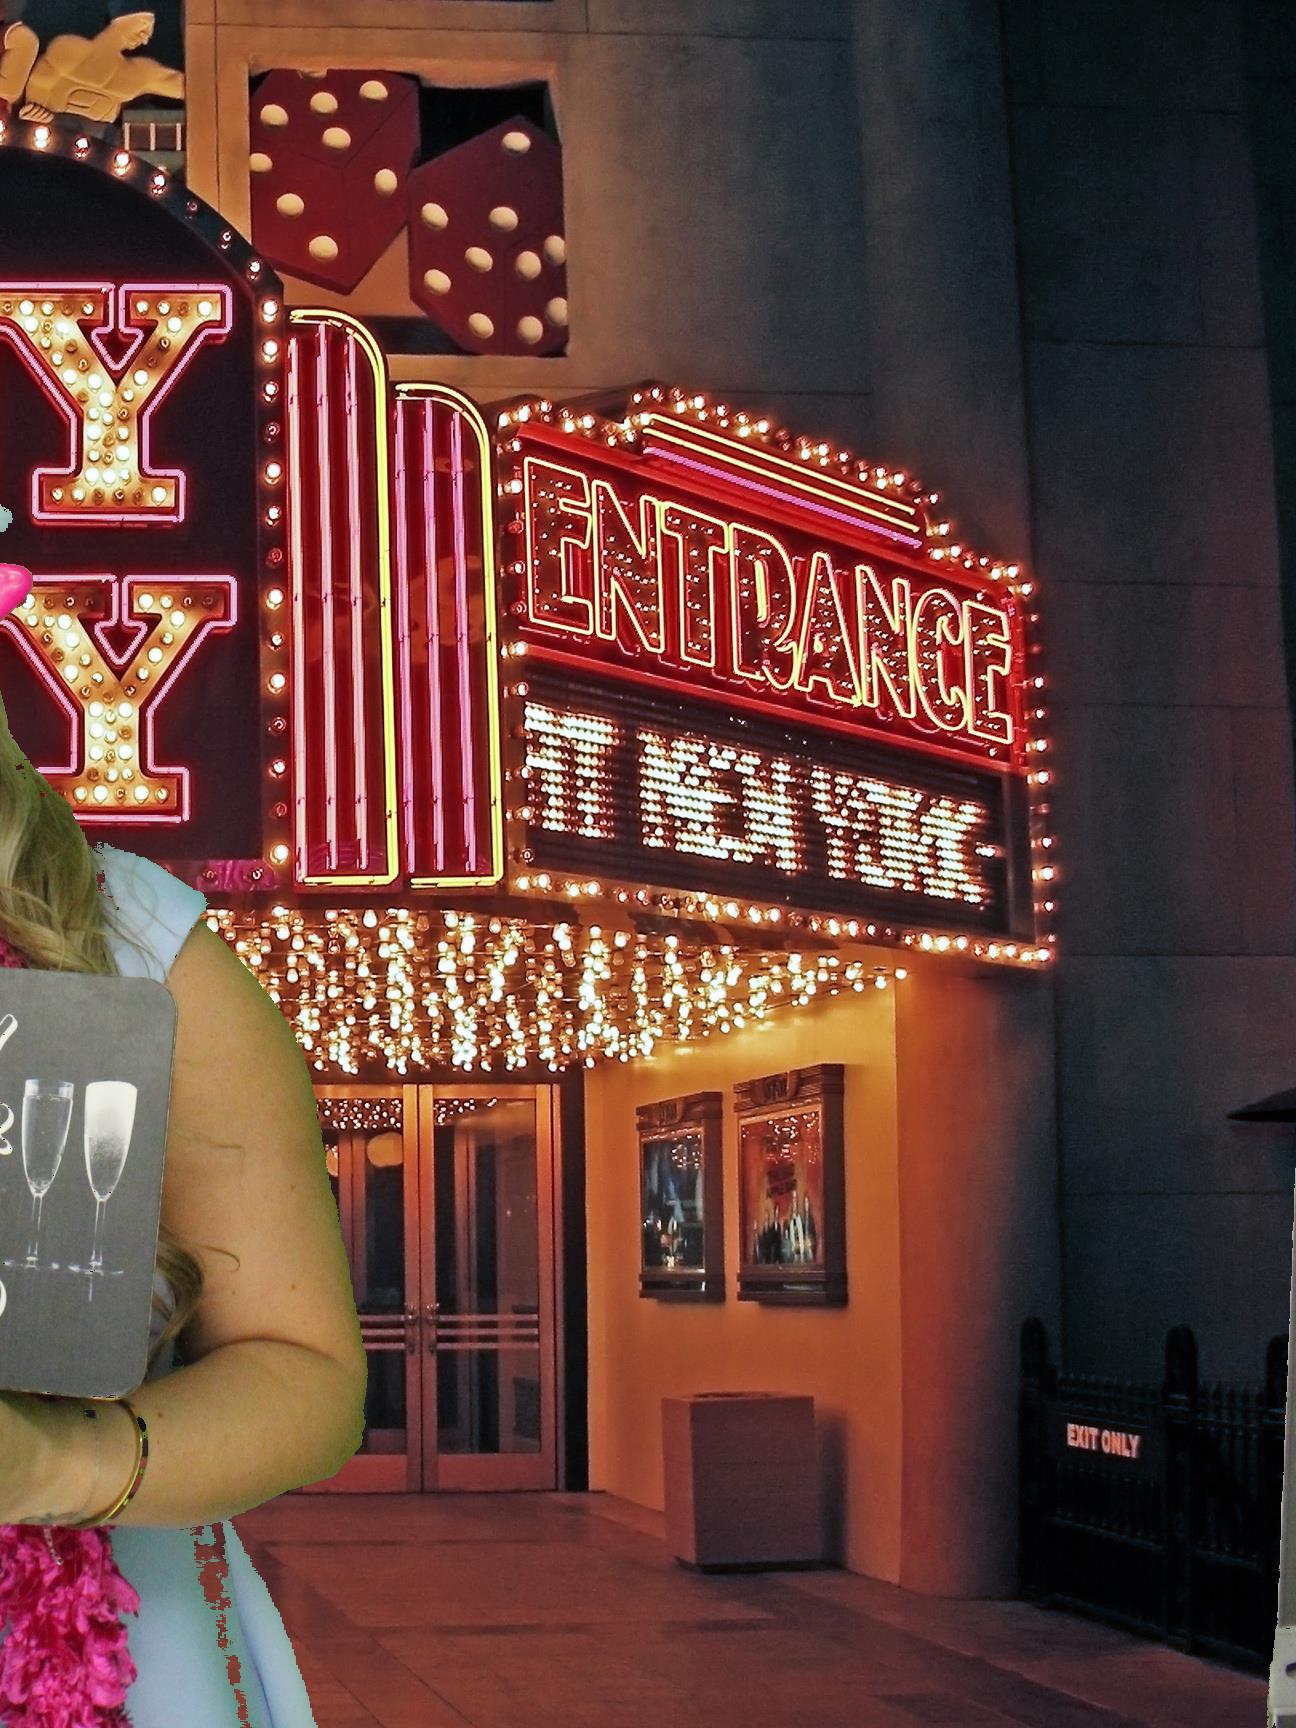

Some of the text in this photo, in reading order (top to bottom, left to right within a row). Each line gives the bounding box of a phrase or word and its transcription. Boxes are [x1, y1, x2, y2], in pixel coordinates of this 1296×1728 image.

[523, 456, 1014, 745] ENTRANCE
[1066, 1422, 1142, 1459] EXIT ONLY
